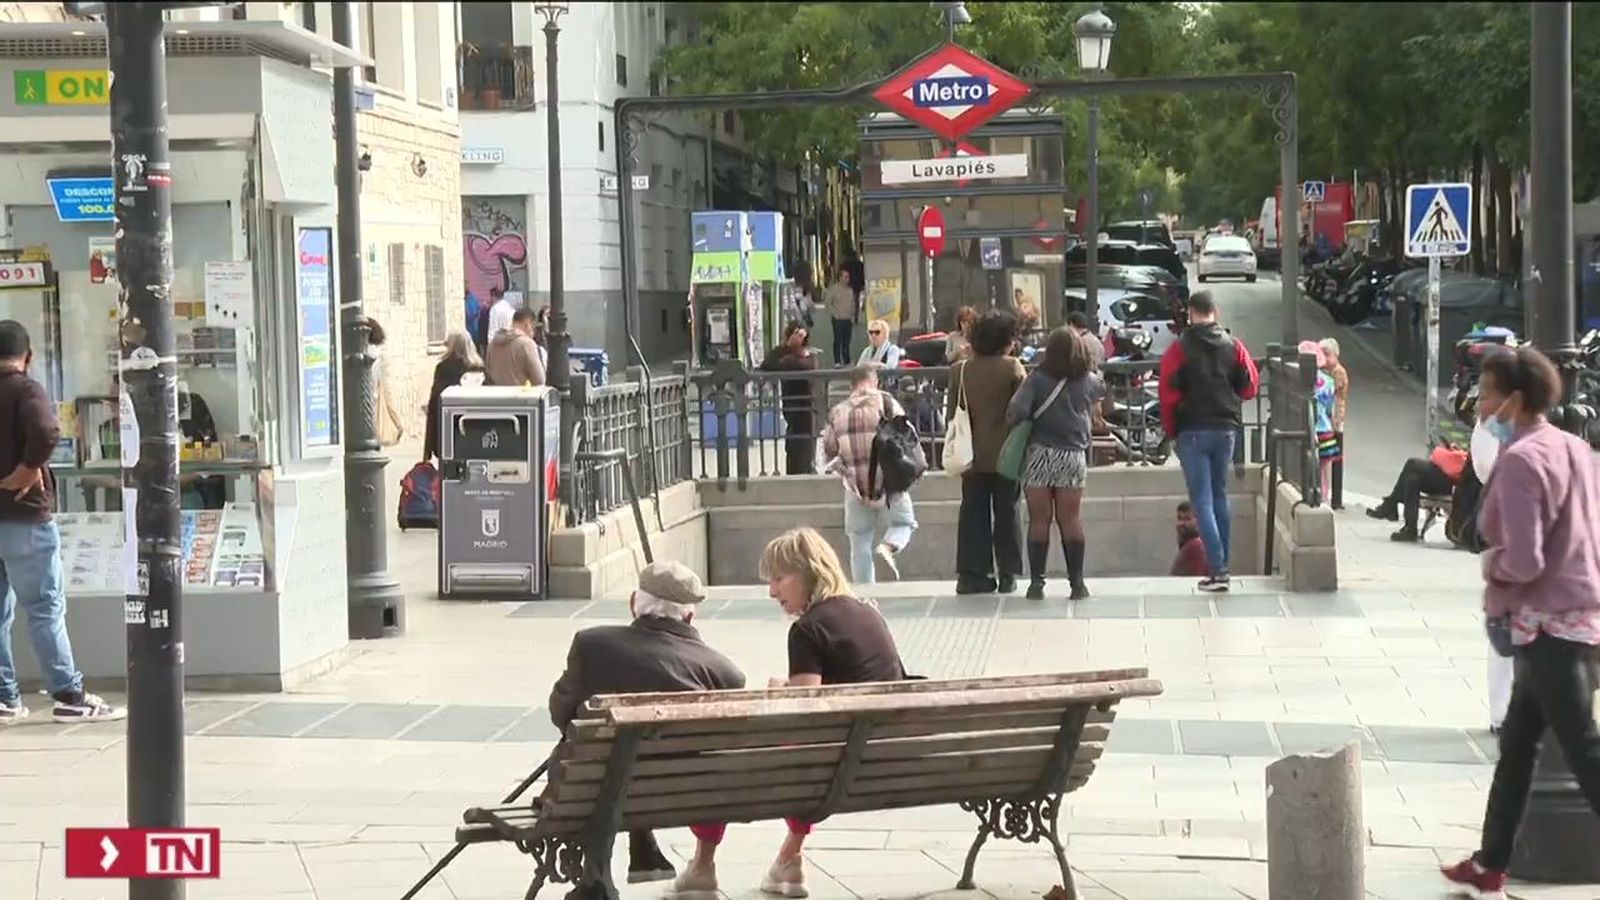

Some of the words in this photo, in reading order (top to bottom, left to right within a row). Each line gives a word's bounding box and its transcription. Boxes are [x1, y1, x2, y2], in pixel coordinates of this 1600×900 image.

[919, 82, 983, 102] Metro
[912, 162, 996, 178] Lavapiés
[473, 540, 508, 548] MADRID
